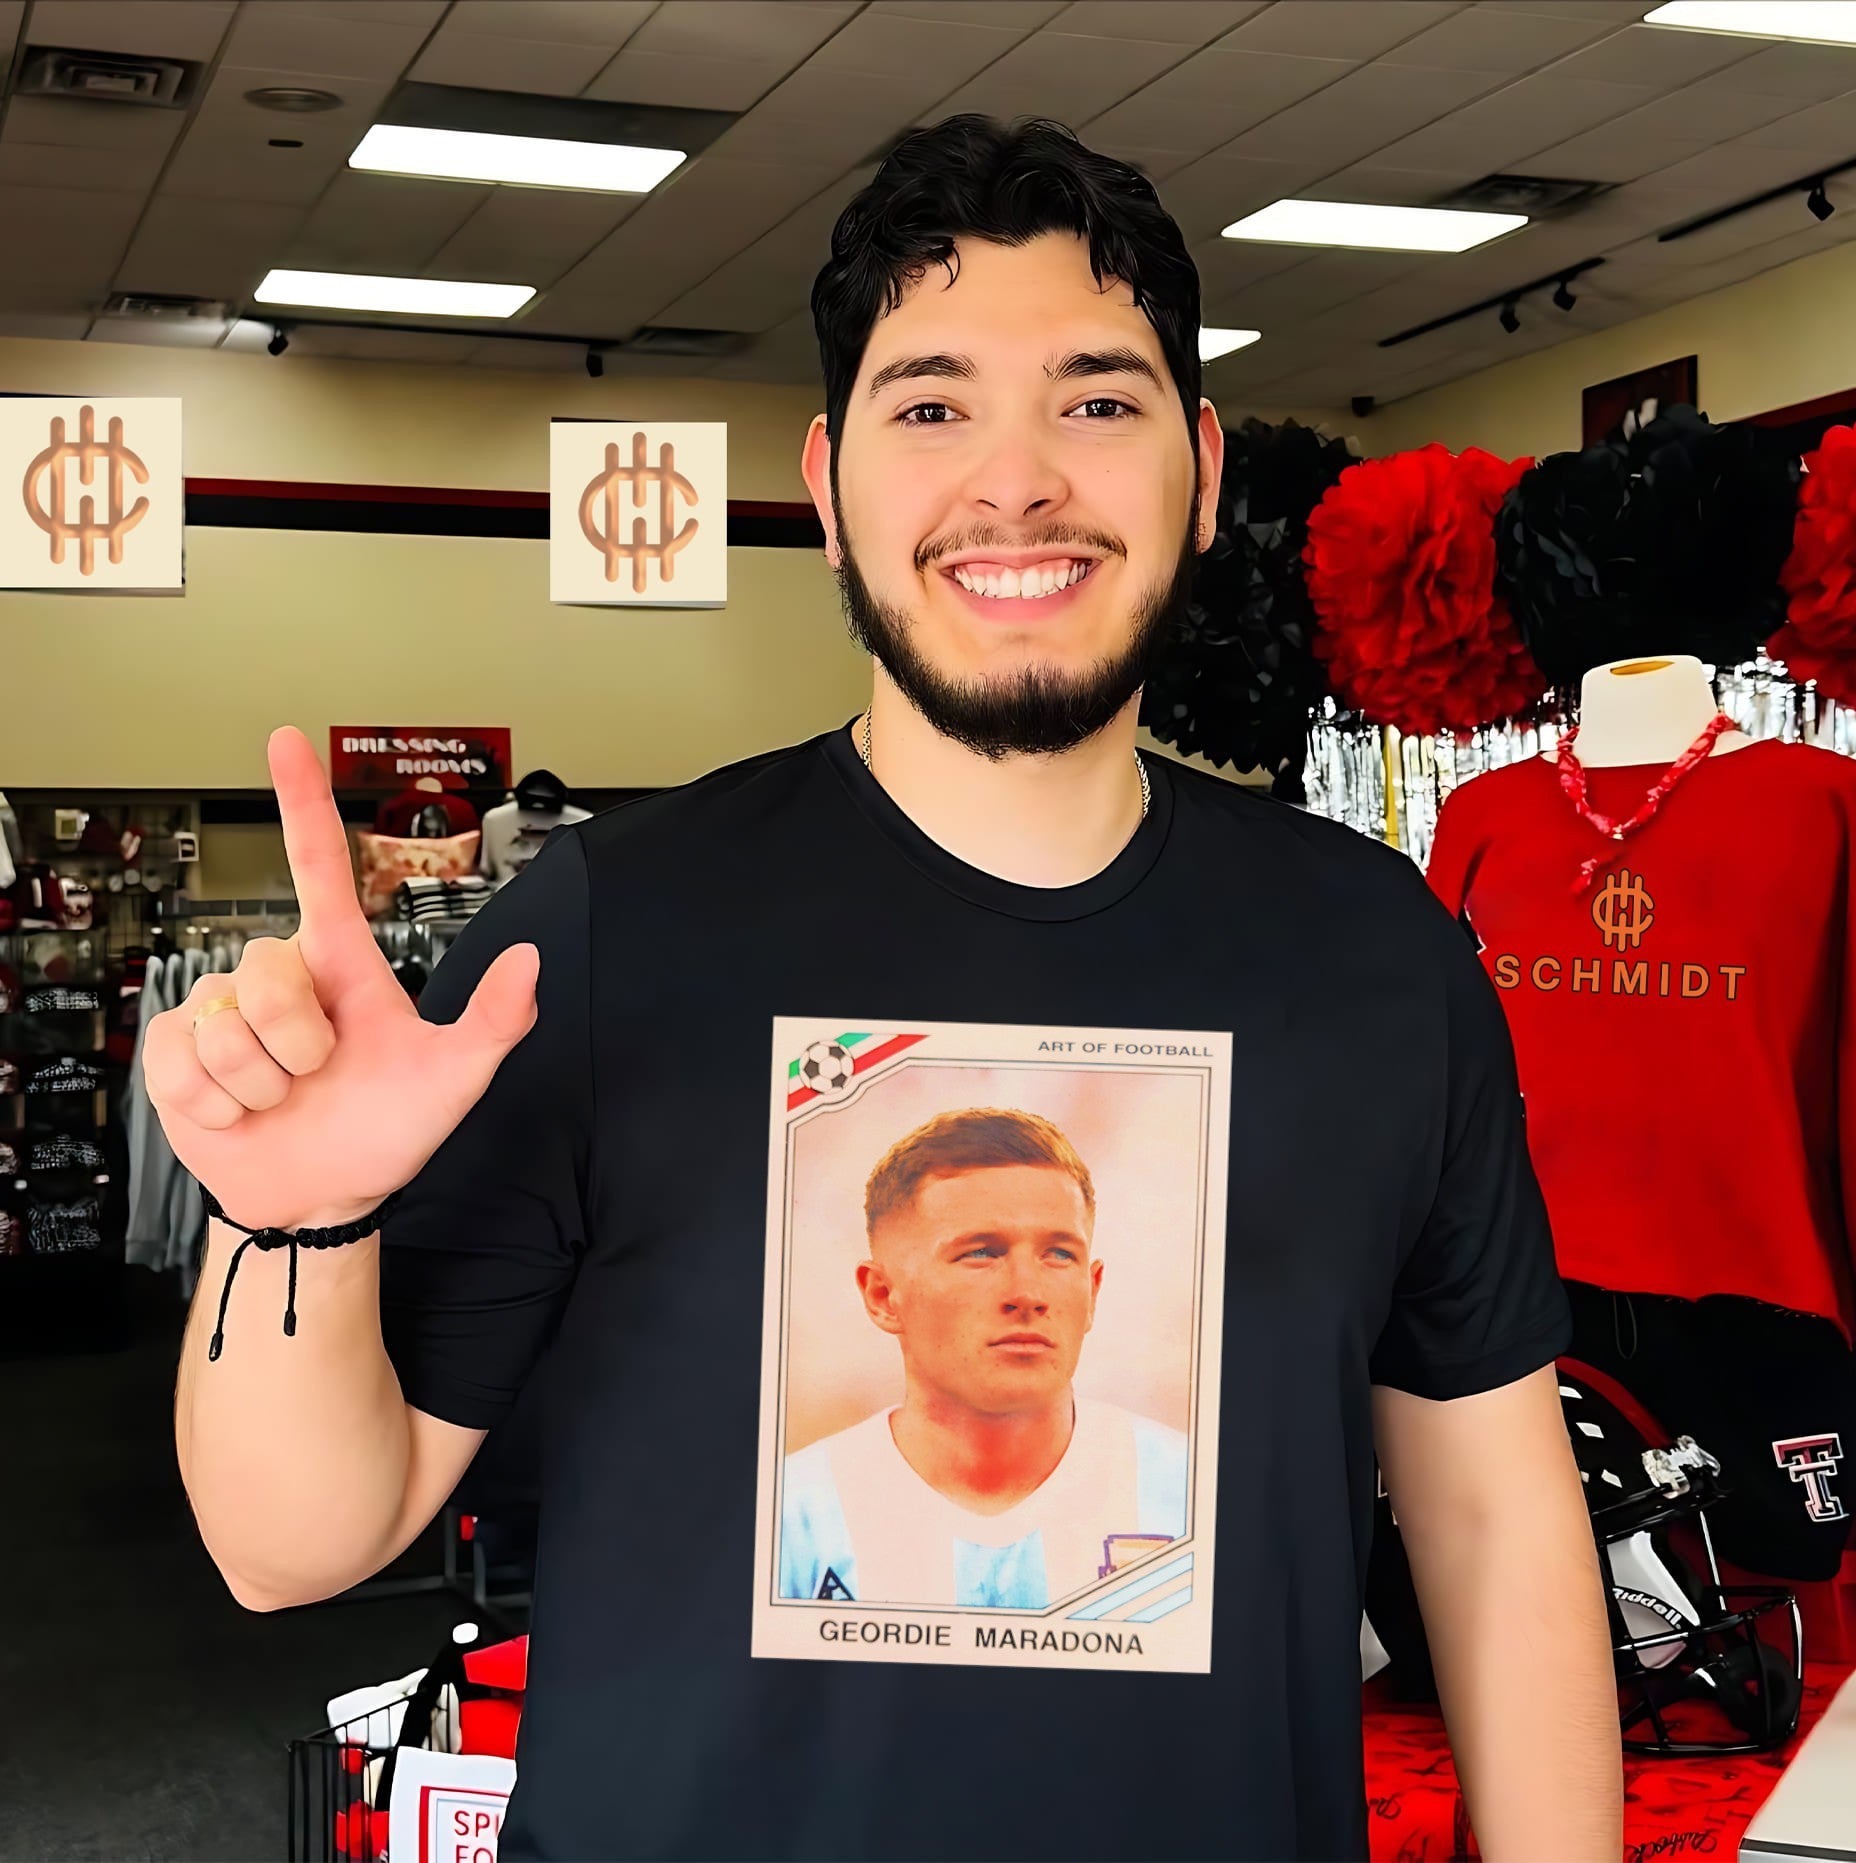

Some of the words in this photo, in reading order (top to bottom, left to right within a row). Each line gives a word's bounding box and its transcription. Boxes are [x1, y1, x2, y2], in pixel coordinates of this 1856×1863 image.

[342, 737, 467, 754] DRESSING
[1494, 953, 1747, 1000] SCHMIDT
[1038, 1041, 1075, 1052] ART
[1082, 1042, 1107, 1053] OF
[1114, 1044, 1214, 1057] FOOTBALL
[818, 1619, 952, 1647] GEORDIE
[974, 1626, 1145, 1656] MARADONA
